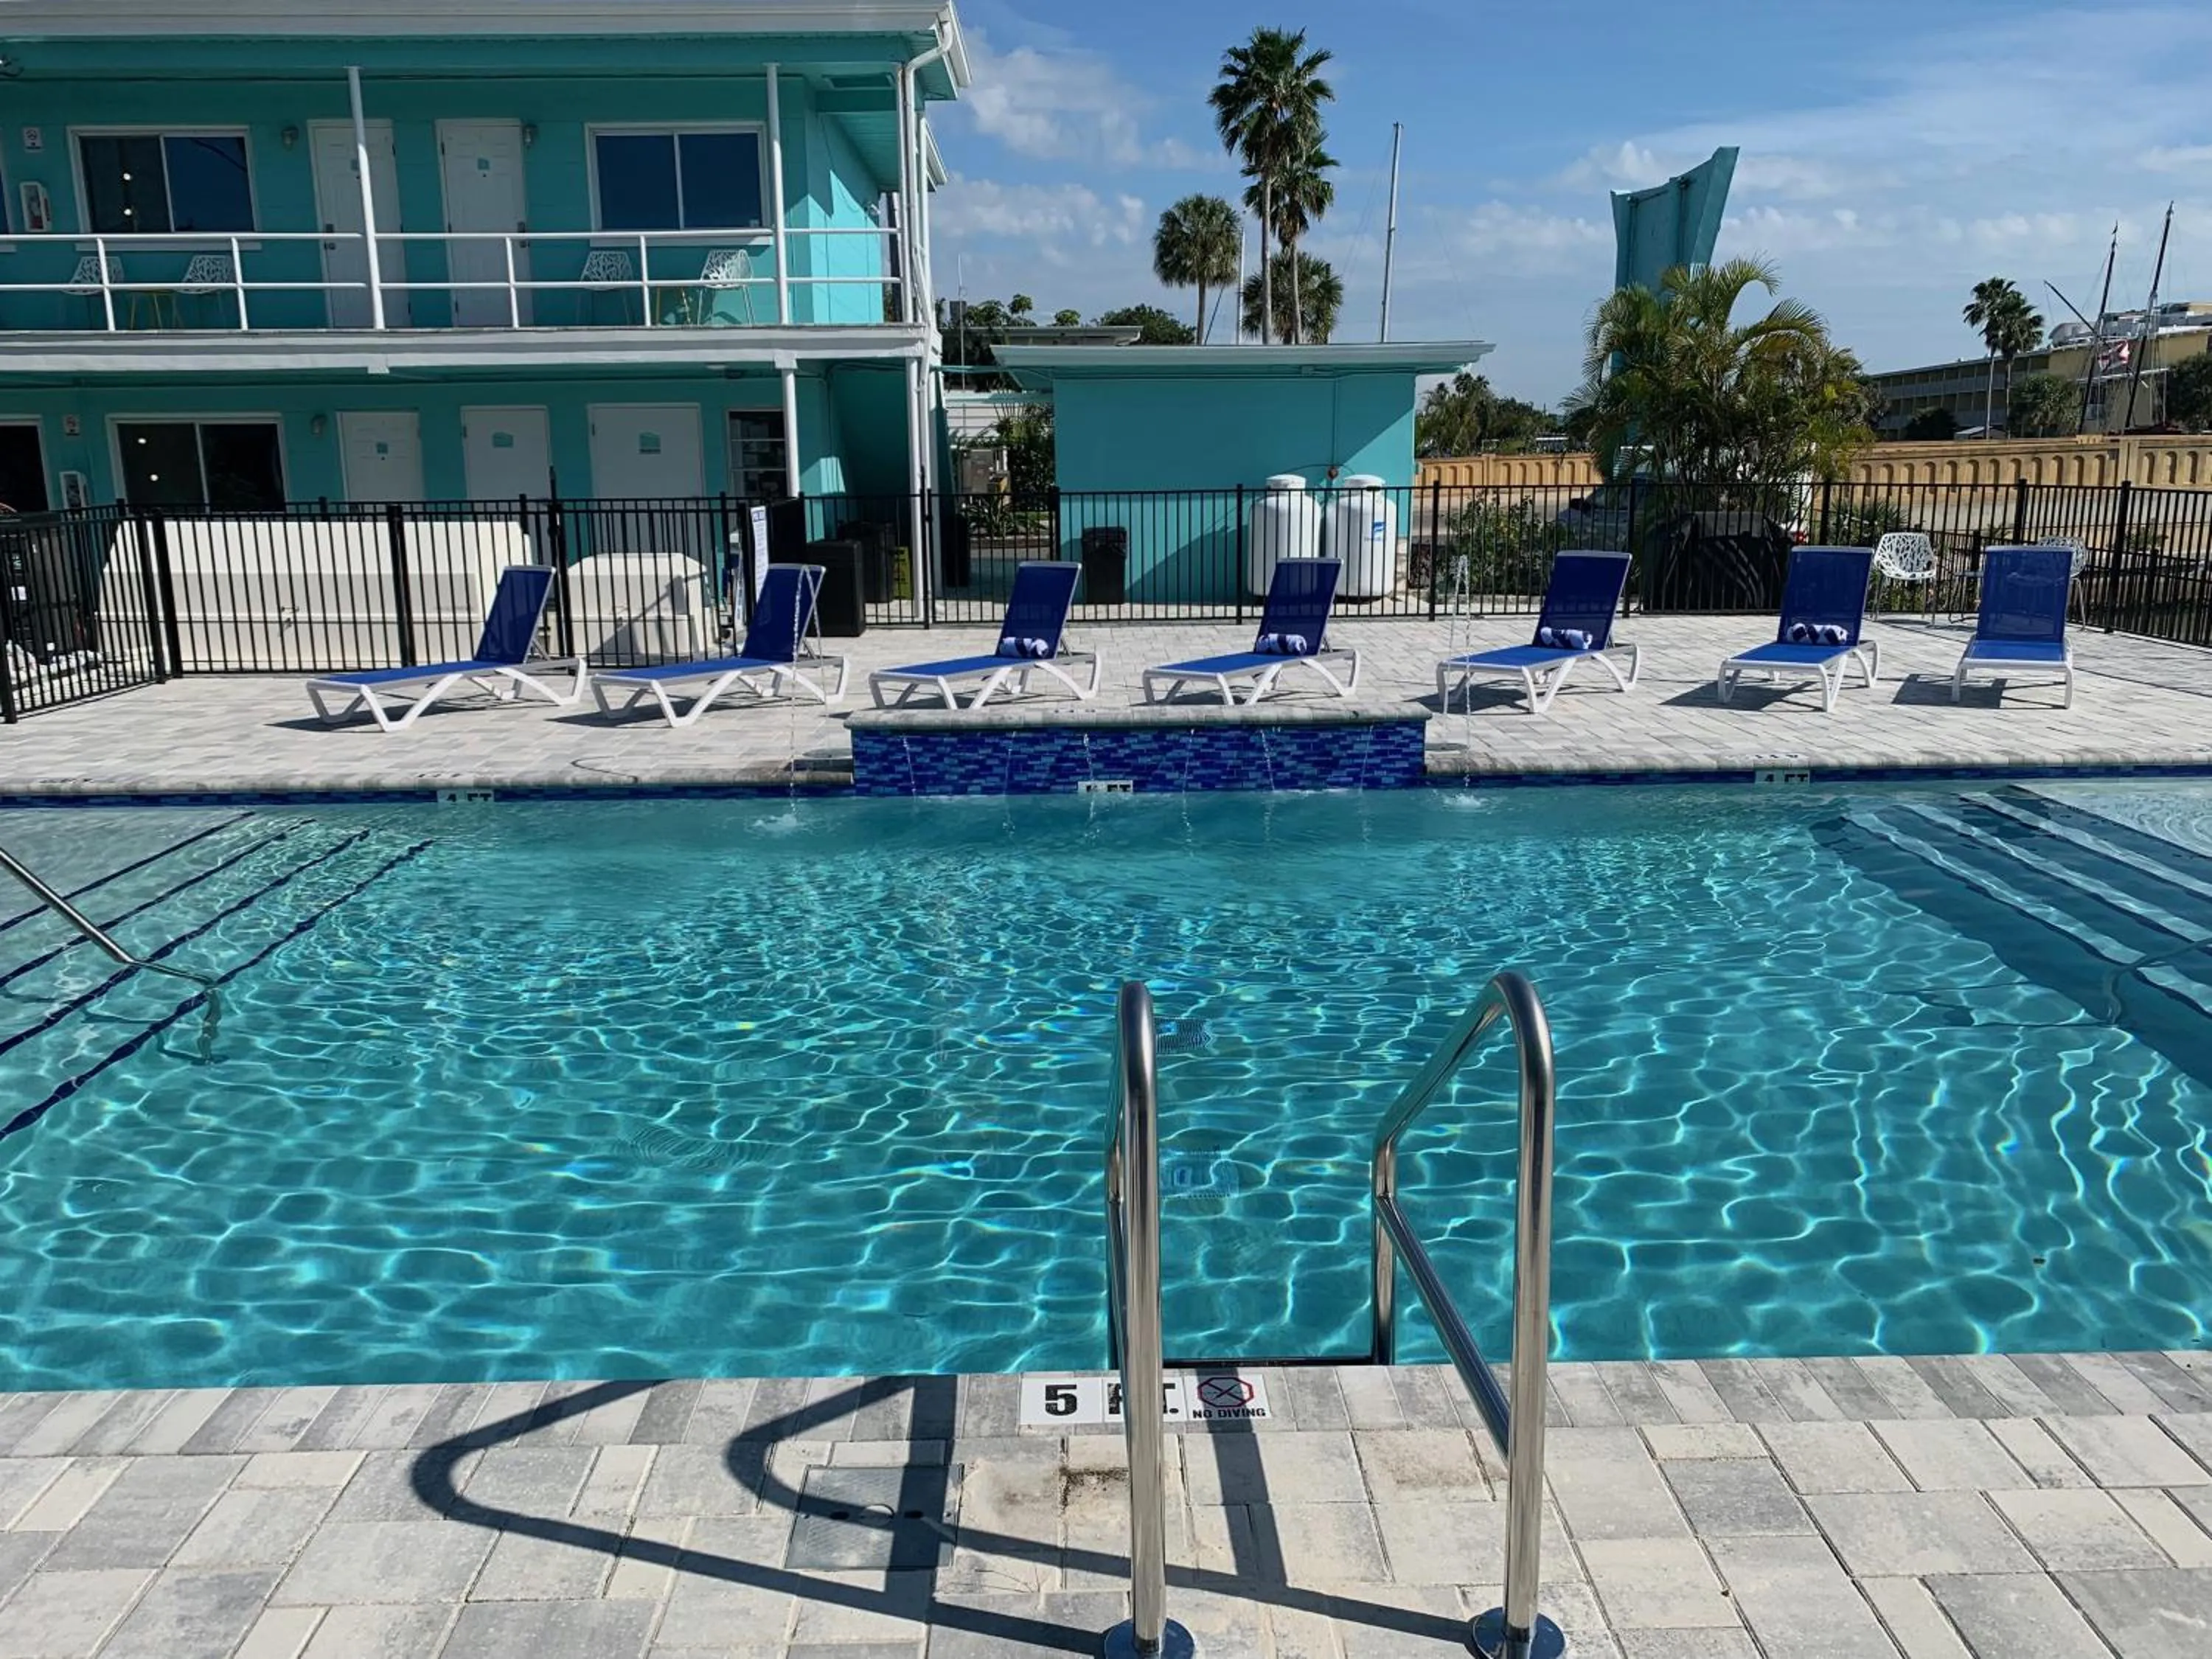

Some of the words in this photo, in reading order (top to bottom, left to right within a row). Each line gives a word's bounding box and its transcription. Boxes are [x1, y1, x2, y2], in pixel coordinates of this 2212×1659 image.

[1045, 1383, 1078, 1416] 5
[1192, 1409, 1213, 1419] NO
[1217, 1408, 1266, 1417] DIVING
